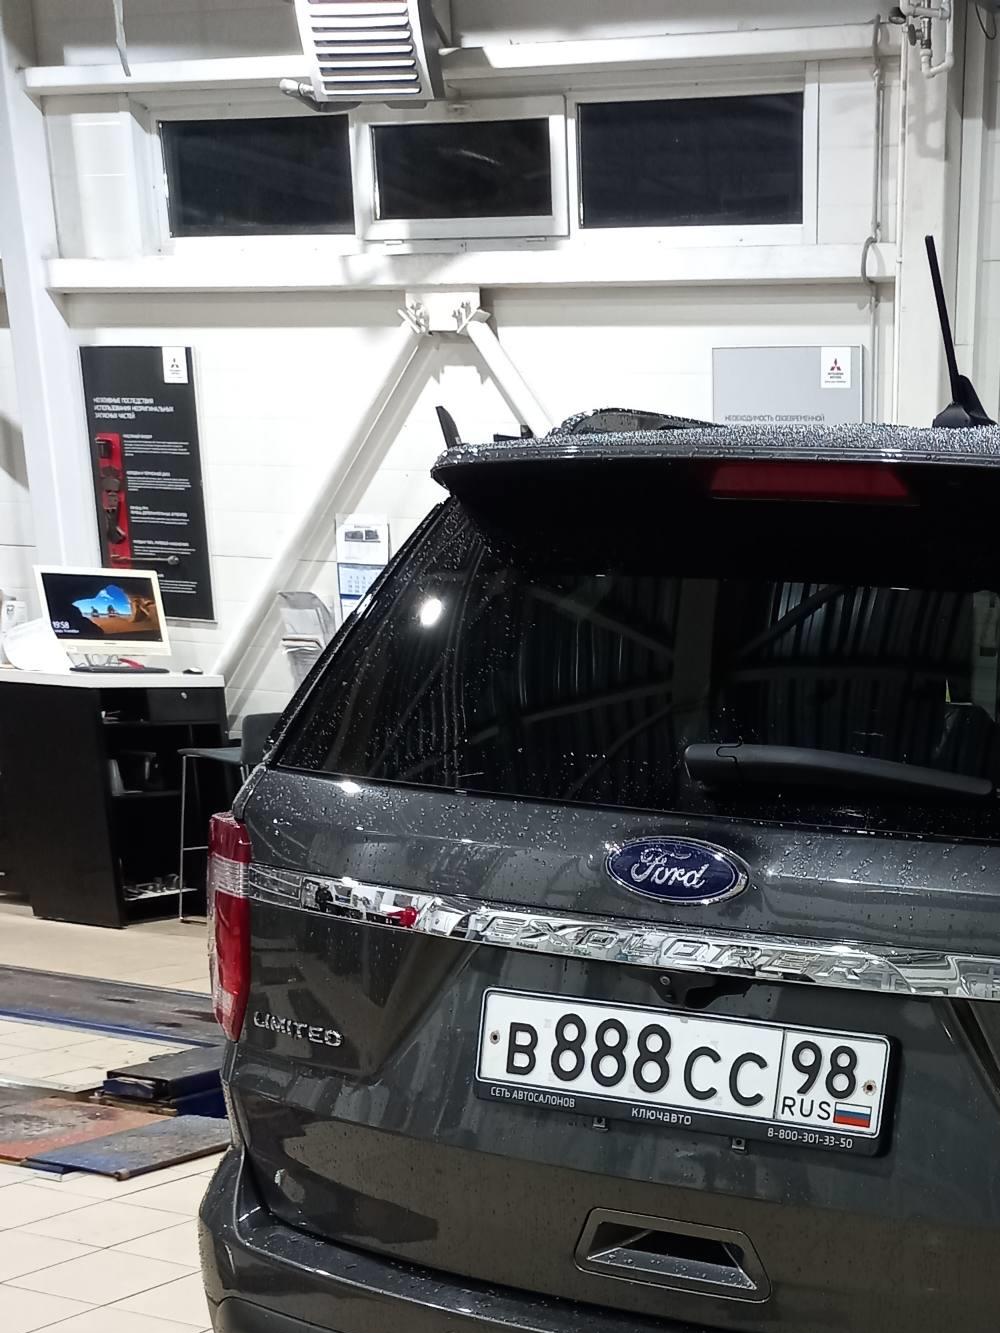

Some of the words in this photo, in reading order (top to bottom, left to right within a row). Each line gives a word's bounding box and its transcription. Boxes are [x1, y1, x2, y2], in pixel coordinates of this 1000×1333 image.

[631, 848, 709, 889] Ford
[484, 914, 874, 981] EXPLORER
[253, 1011, 343, 1047] LIMITED
[791, 1040, 858, 1099] 98
[490, 1086, 511, 1098] СЕТЬ
[512, 1088, 576, 1108] АВТОСАЛОНОВ
[781, 1096, 831, 1120] RUS
[767, 1127, 853, 1149] 8-800-301-33-50
